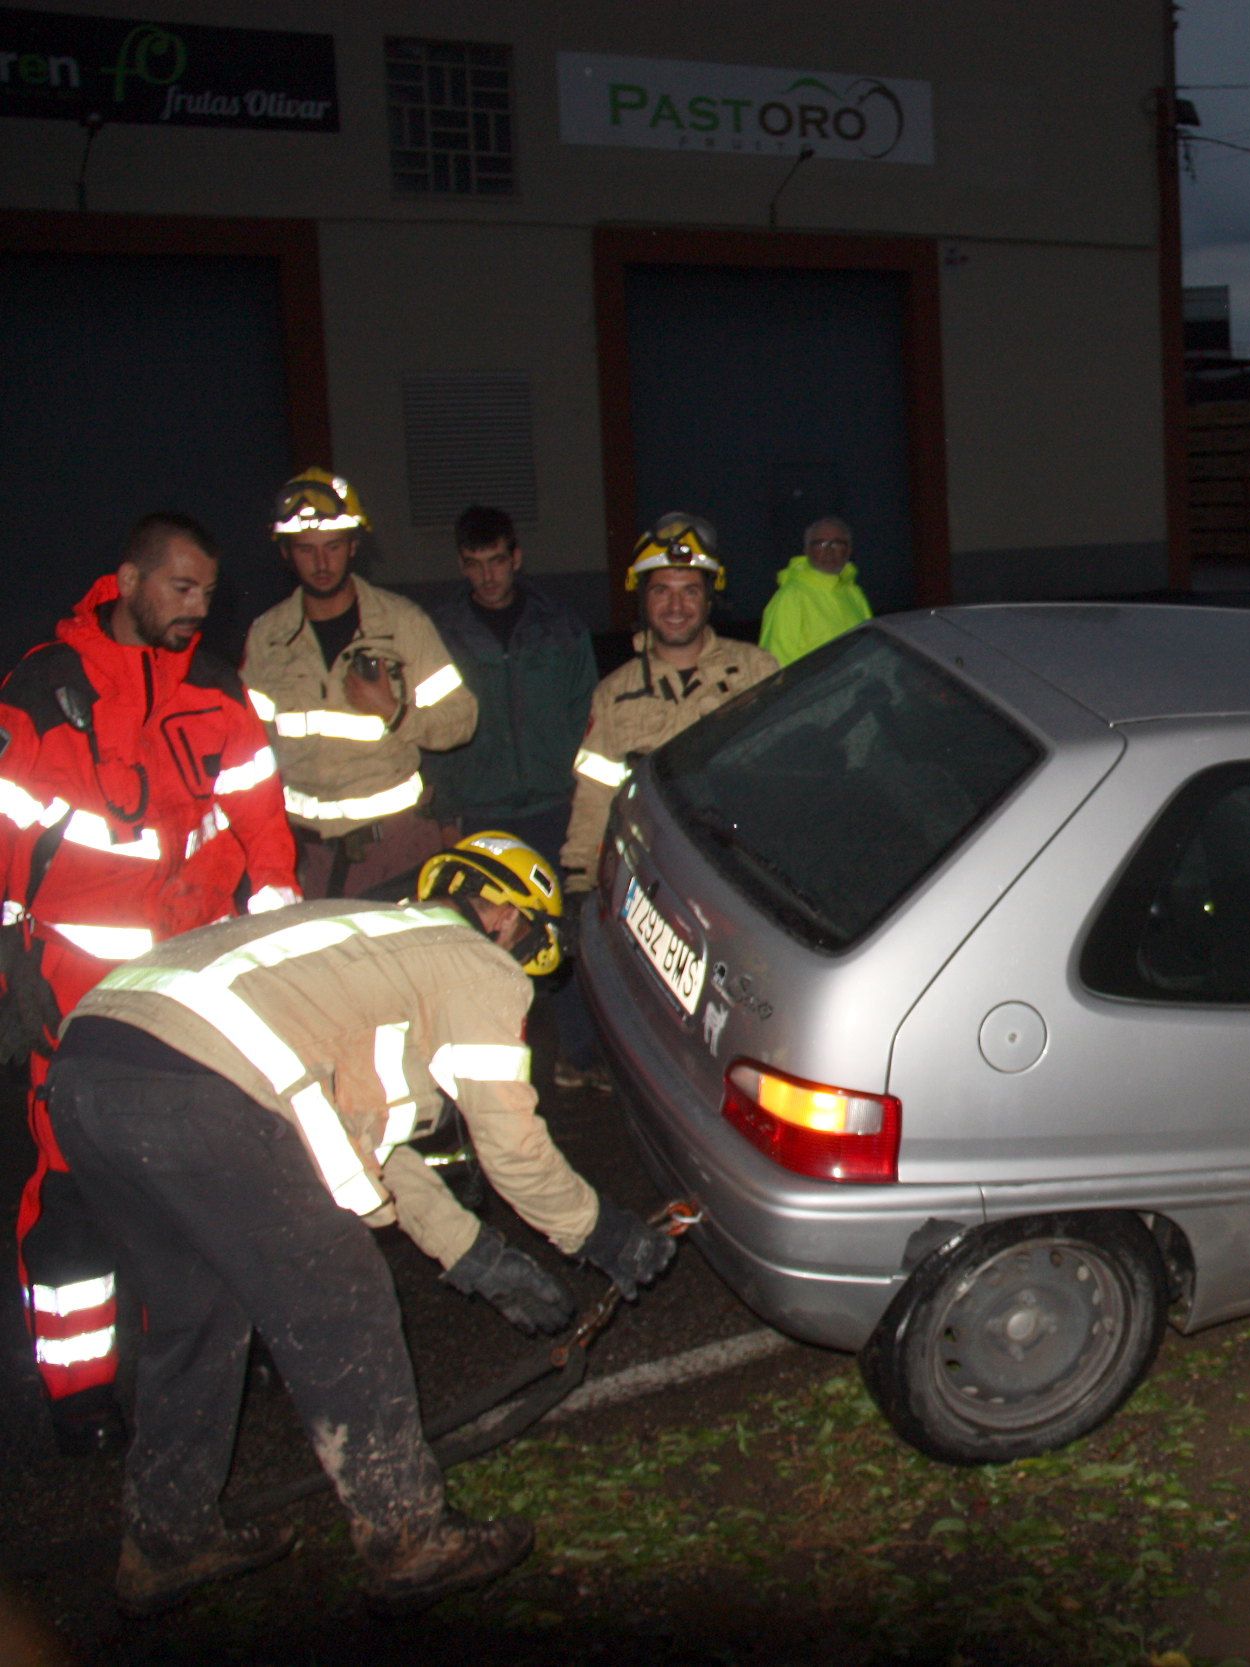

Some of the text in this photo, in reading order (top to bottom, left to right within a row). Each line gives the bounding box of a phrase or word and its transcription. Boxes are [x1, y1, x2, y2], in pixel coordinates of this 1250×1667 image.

[160, 86, 332, 120] frutas Olivar
[608, 83, 867, 141] PASTORO
[663, 931, 699, 998] BMS
